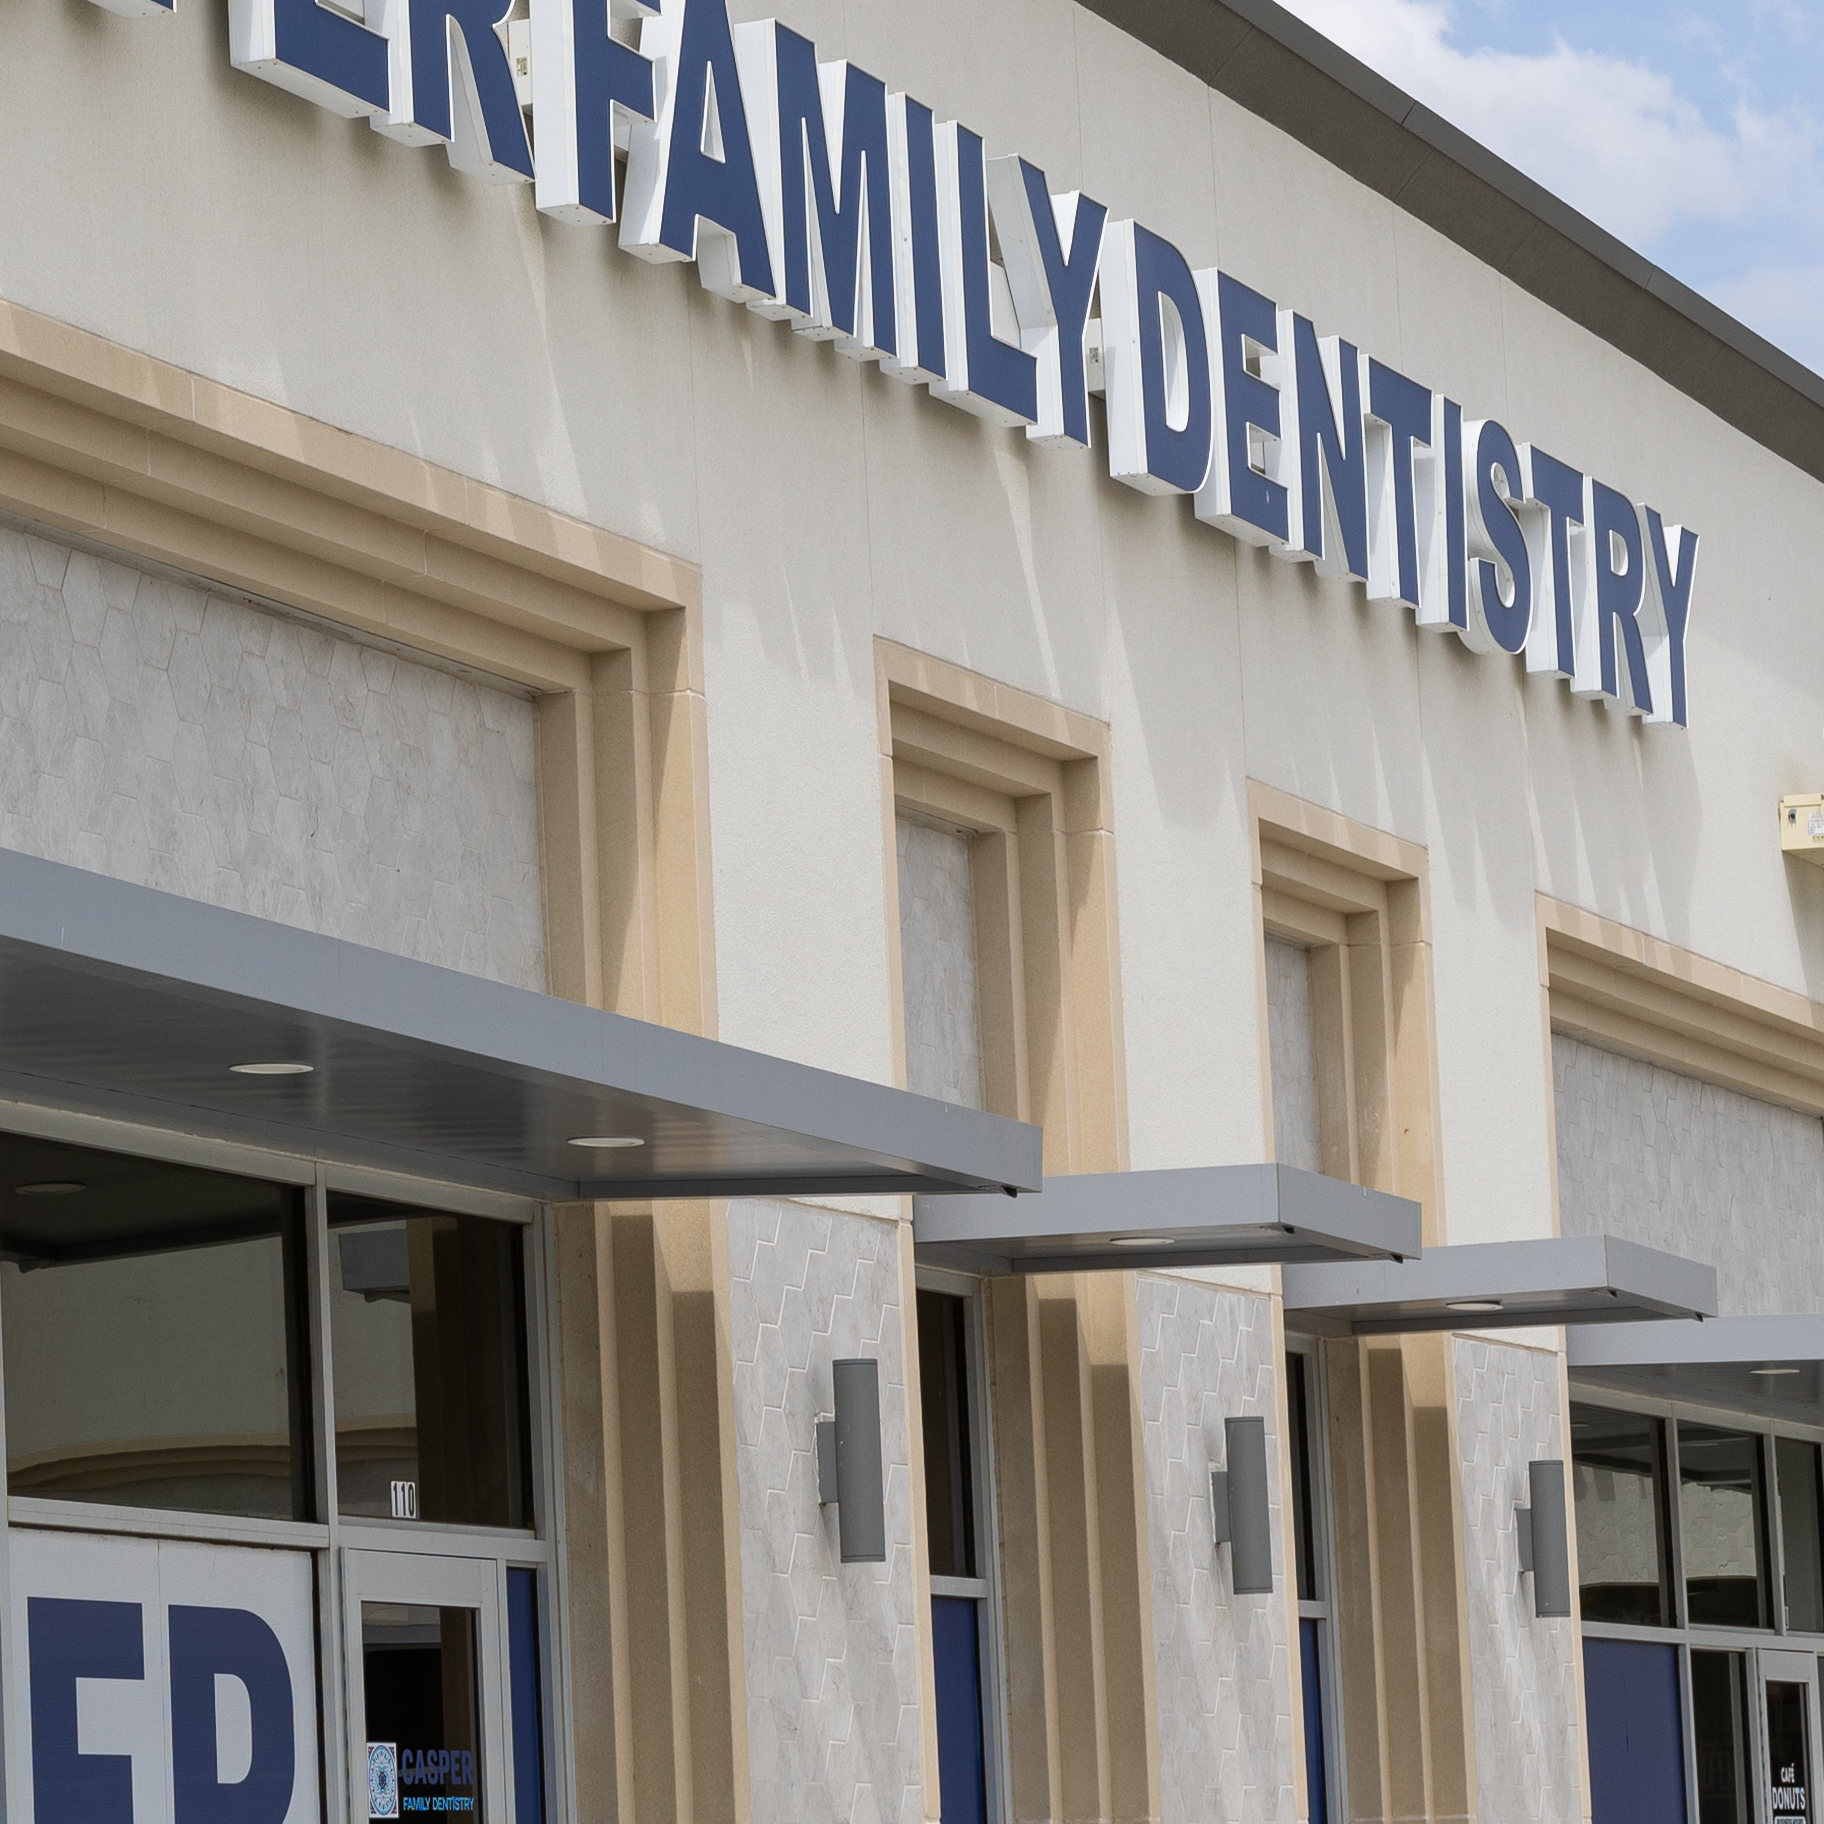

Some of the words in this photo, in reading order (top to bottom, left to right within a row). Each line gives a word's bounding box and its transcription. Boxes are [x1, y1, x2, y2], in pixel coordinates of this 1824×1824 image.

[1130, 220, 1699, 730] DENTISTRY
[392, 1481, 416, 1518] 110
[401, 1748, 474, 1786] CASPER
[1780, 1762, 1795, 1784] CAFÉ
[403, 1796, 431, 1812] FAMILY
[432, 1795, 475, 1812] DENTISTRY
[1771, 1786, 1806, 1810] DONUTS
